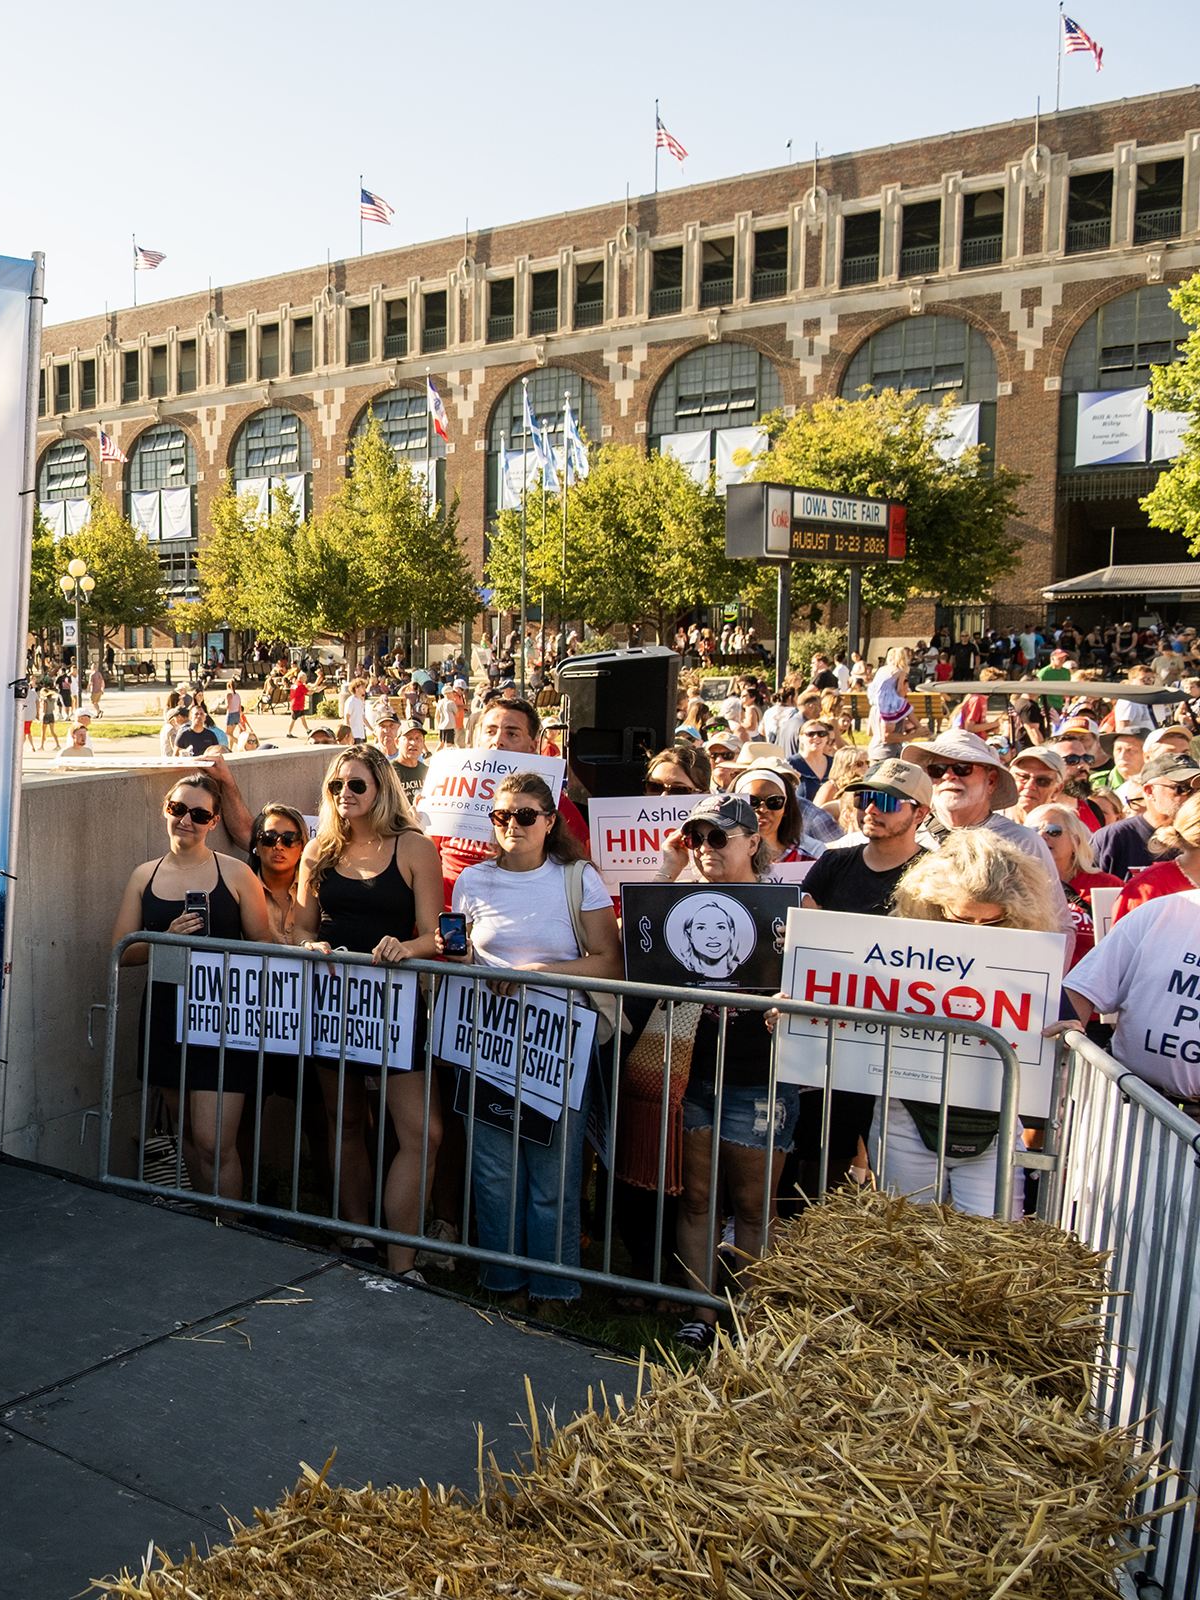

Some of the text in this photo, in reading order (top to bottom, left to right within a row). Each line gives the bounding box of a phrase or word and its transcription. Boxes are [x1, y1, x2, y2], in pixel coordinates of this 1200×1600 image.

[802, 496, 880, 523] IOWA STATE FAIR
[792, 531, 830, 550] AUGUST
[431, 776, 497, 800] HINS
[451, 801, 494, 812] FOR SEN
[637, 807, 692, 822] Ashle
[449, 837, 496, 854] HINS
[606, 828, 677, 852] HIN
[637, 857, 658, 865] FOR
[864, 943, 975, 980] Ashley
[189, 965, 240, 1004] IOWA
[347, 977, 402, 1021] CANT
[458, 986, 519, 1037] IOWA
[804, 969, 1032, 1032] HINSON
[245, 1008, 299, 1040] ASHLEY
[346, 1017, 400, 1053] ASHLY
